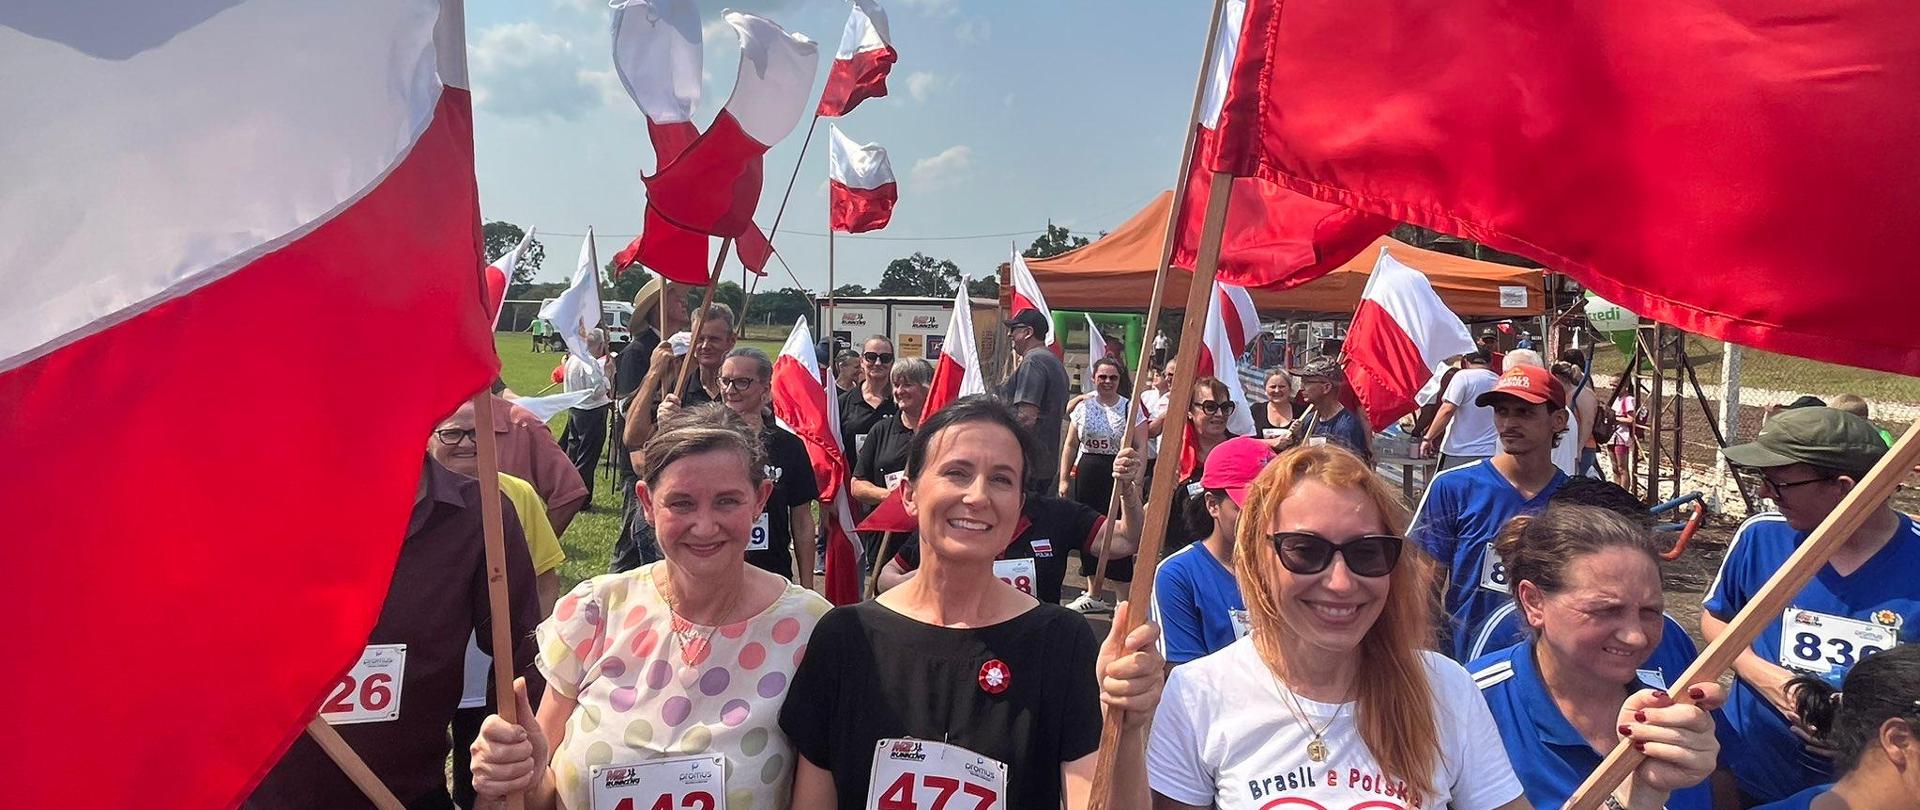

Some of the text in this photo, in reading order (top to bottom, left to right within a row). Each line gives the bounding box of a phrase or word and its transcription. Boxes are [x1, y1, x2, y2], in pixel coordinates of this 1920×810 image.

[1085, 439, 1108, 449] 495
[1000, 575, 1031, 595] 8
[878, 772, 997, 810] 477
[1248, 766, 1316, 800] Brasil
[1327, 770, 1337, 786] e
